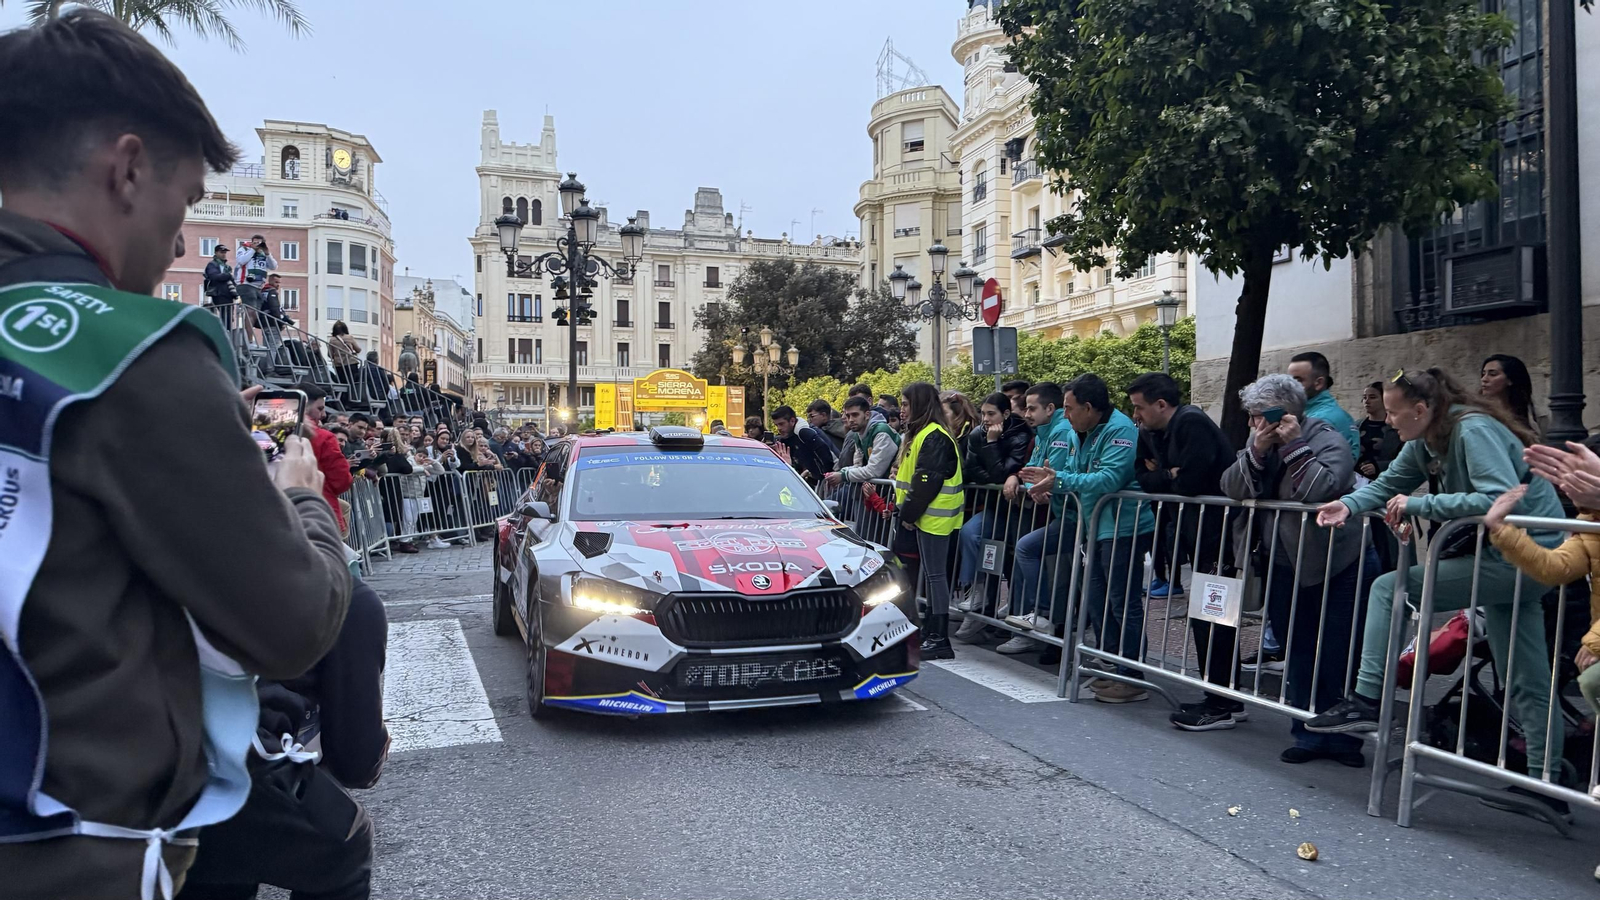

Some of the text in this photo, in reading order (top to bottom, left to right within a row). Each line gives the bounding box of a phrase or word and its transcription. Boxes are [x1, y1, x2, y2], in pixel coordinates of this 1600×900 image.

[43, 286, 115, 315] SAFETY
[12, 305, 67, 336] 1st
[868, 678, 897, 696] MICHELIN
[599, 699, 654, 712] MICHELIN
